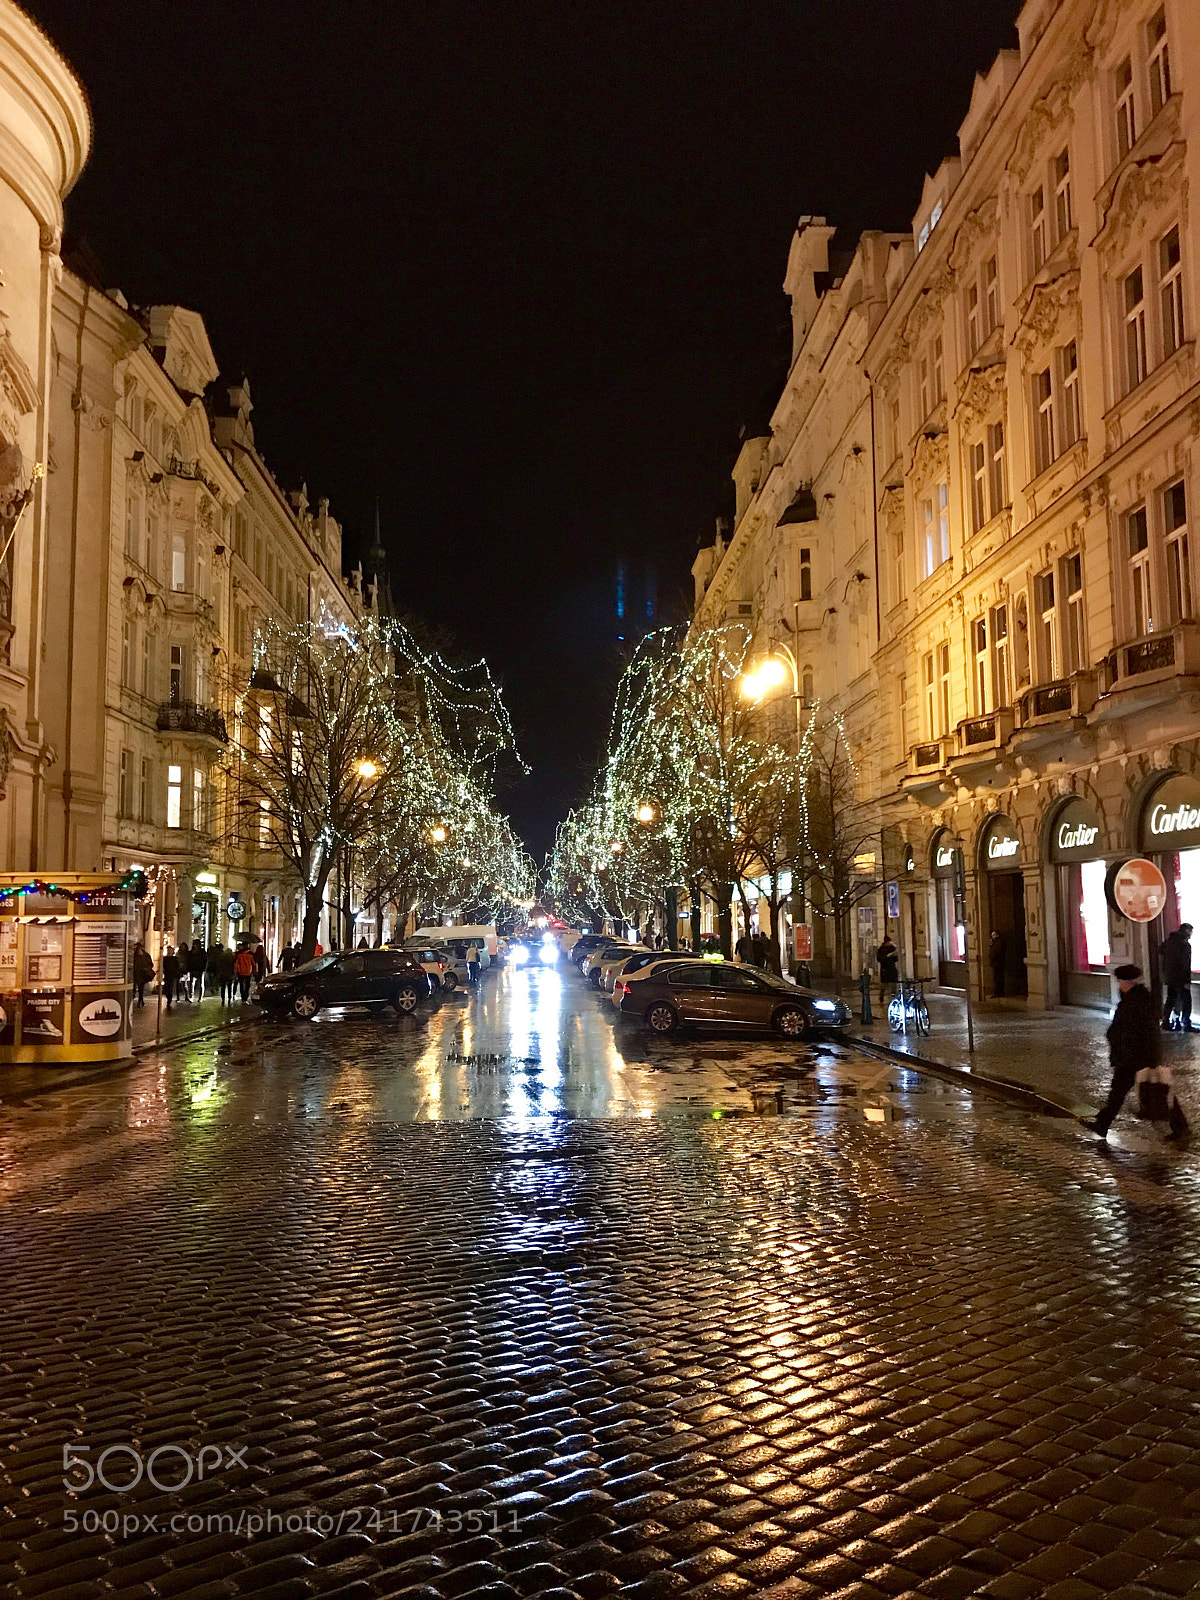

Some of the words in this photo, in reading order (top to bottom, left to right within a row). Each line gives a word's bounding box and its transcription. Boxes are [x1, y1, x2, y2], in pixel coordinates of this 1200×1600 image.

[1058, 822, 1098, 849] Cartier
[936, 846, 955, 867] Cart
[988, 836, 1020, 859] Cartier
[889, 886, 896, 905] P
